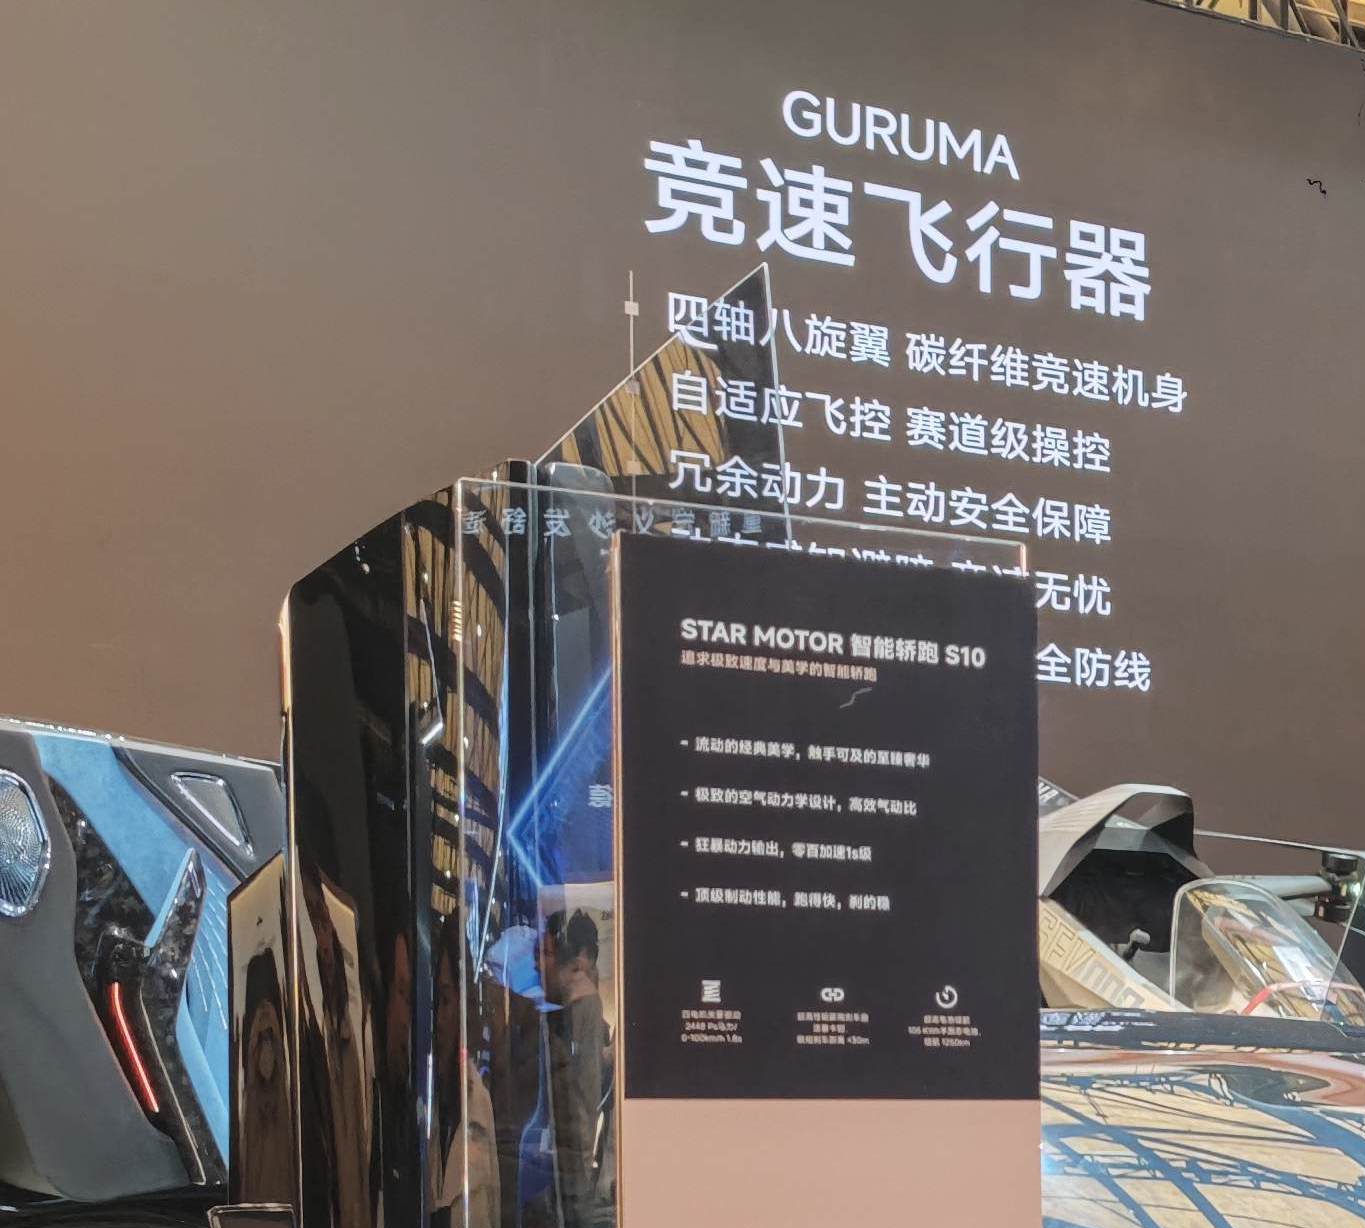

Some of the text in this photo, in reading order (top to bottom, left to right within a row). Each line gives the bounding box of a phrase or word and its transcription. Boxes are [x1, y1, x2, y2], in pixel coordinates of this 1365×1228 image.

[782, 90, 1020, 181] GURUMA
[643, 139, 1152, 320] 竞速飞行器
[667, 291, 1188, 413] 四轴八旋翼 碳纤维竞速机身
[671, 370, 1112, 473] 自适应飞控 赛道级操控
[669, 450, 1112, 545] 冗余动力 主动安全保障
[681, 618, 987, 669] STAR MOTOR 智能轿跑 S10
